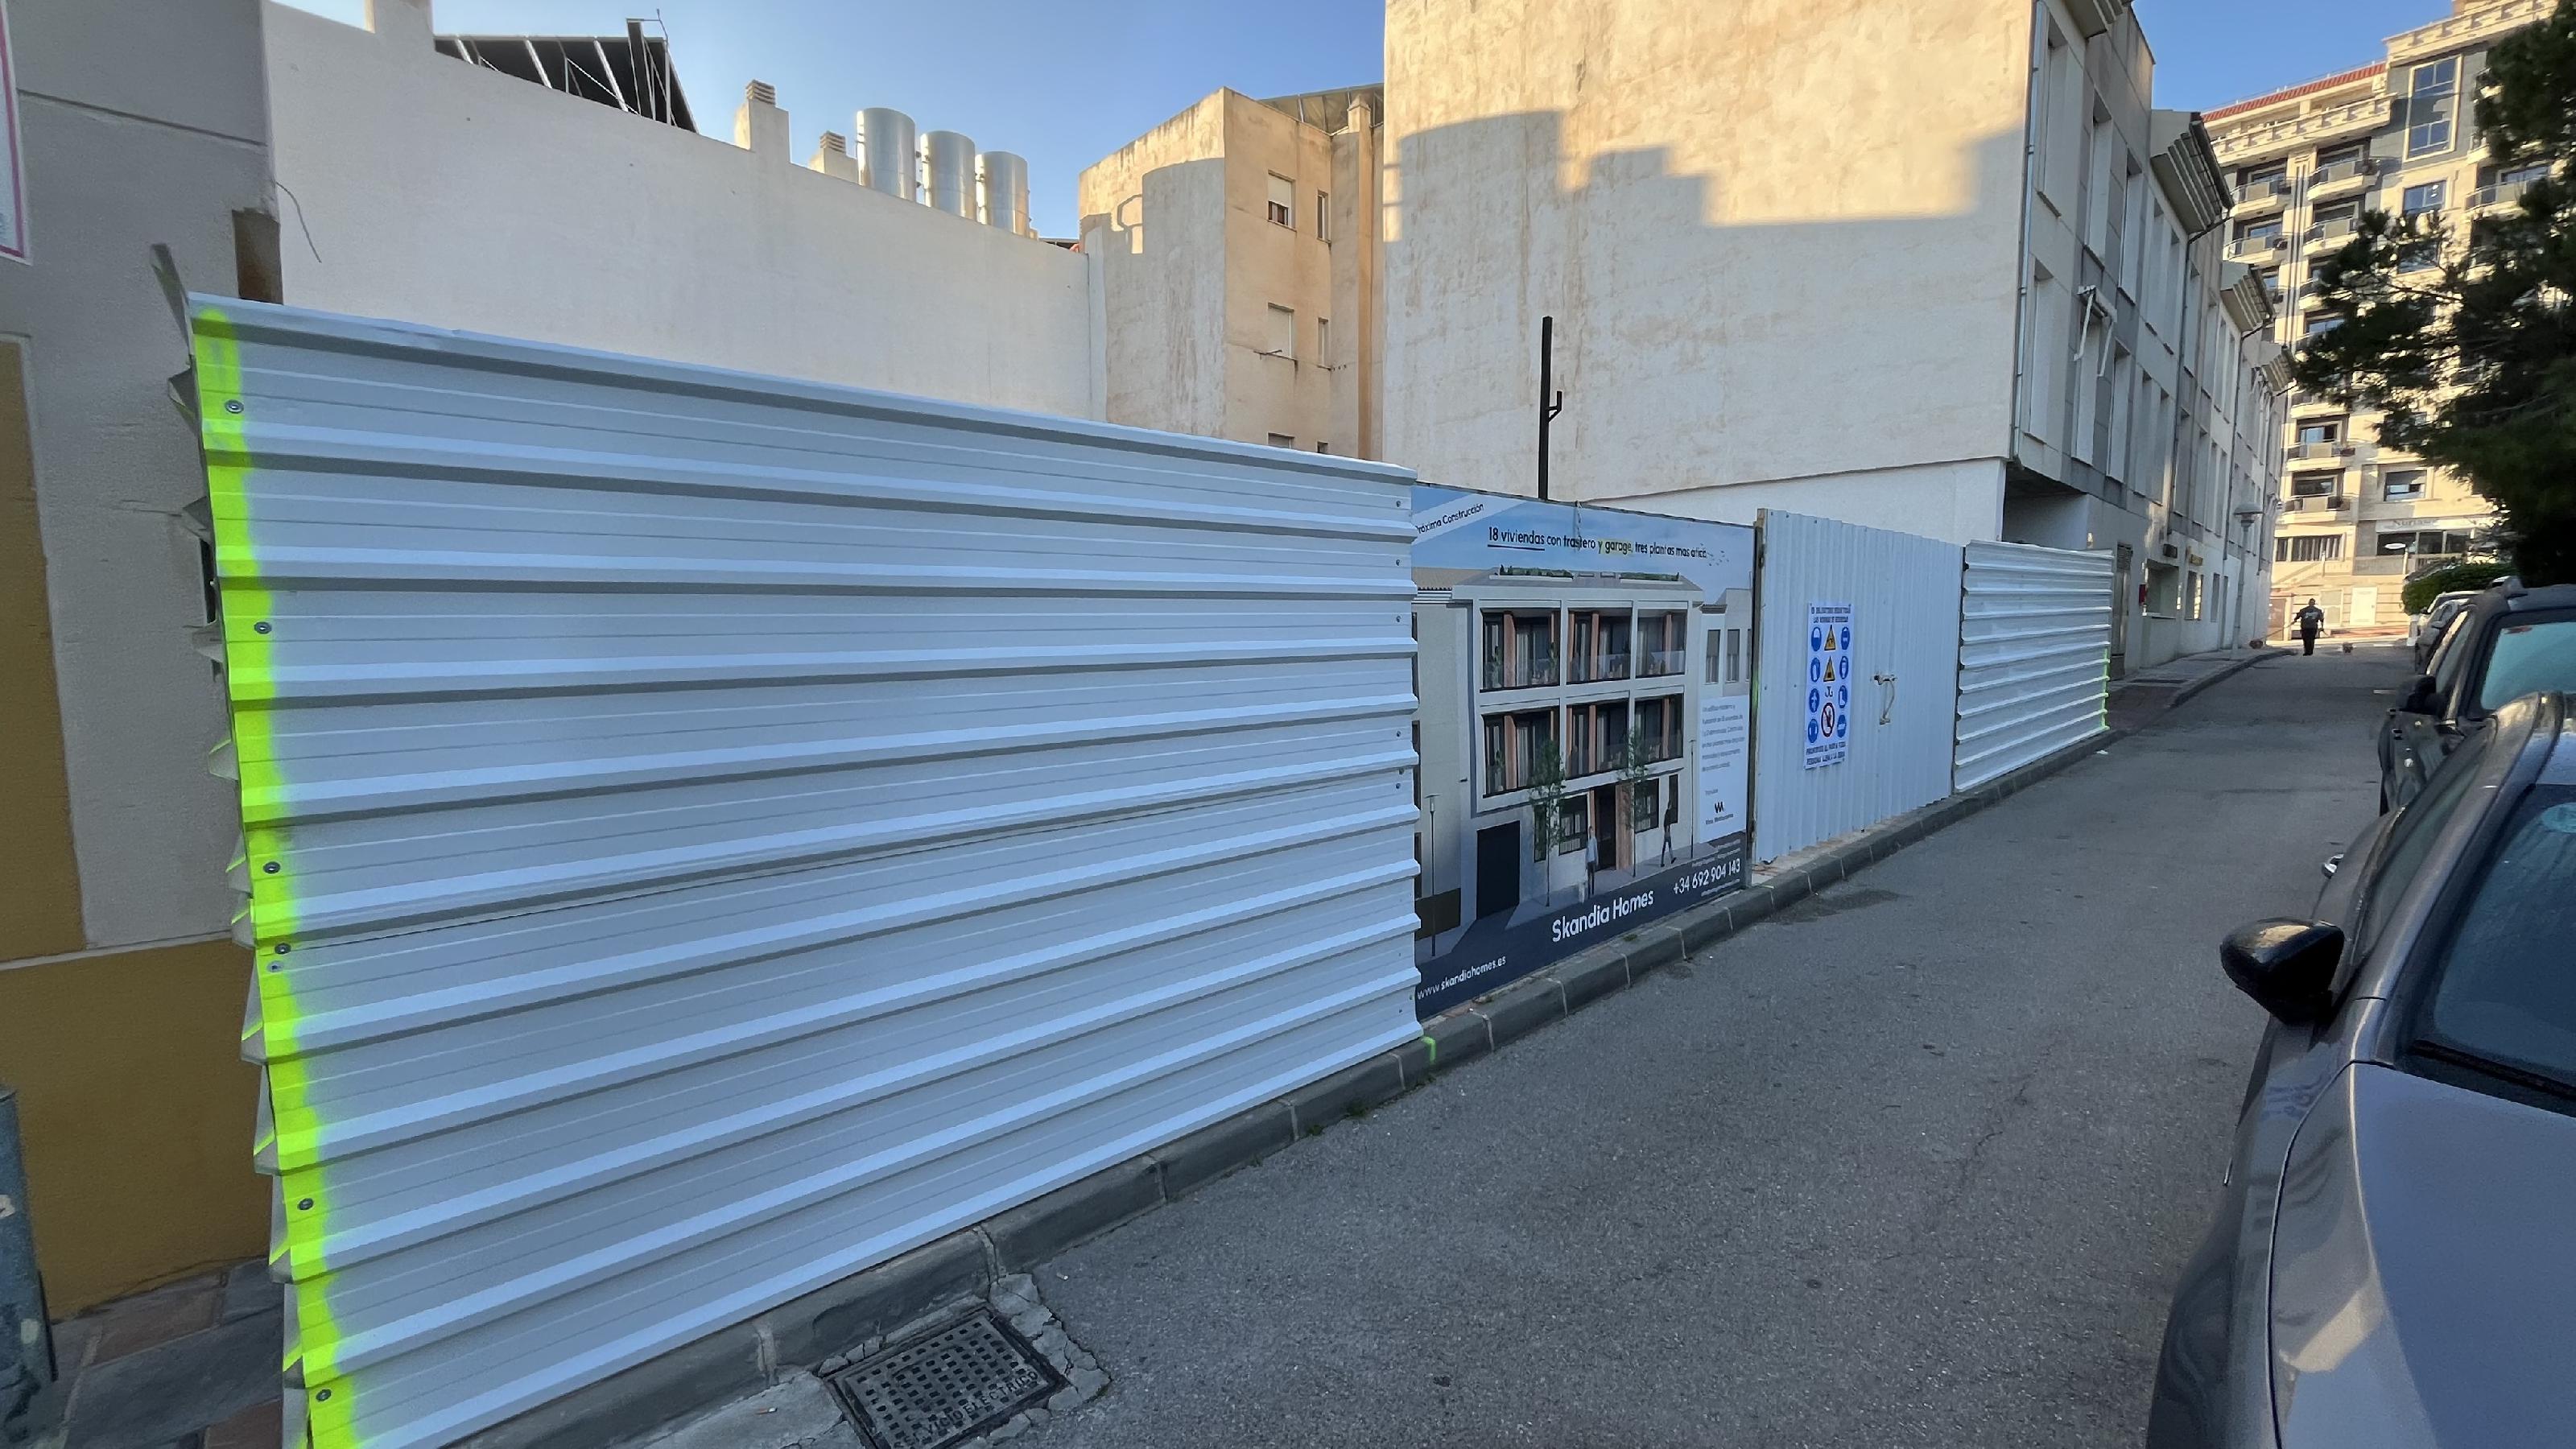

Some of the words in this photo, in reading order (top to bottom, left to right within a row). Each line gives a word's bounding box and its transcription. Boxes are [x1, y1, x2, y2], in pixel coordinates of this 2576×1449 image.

[1489, 526, 1498, 541] 18
[1501, 529, 1545, 545] viviendas
[1546, 535, 1562, 547] con
[1563, 535, 1596, 549] trastero
[1598, 539, 1604, 554] y
[1635, 541, 1648, 554] tres
[1649, 541, 1674, 558] plantas
[1674, 875, 1690, 894] +34
[1692, 869, 1709, 889] 692
[1711, 863, 1727, 882] 904
[1728, 857, 1740, 876] 143
[1552, 904, 1610, 942] Skandia
[1612, 890, 1653, 919] Homes
